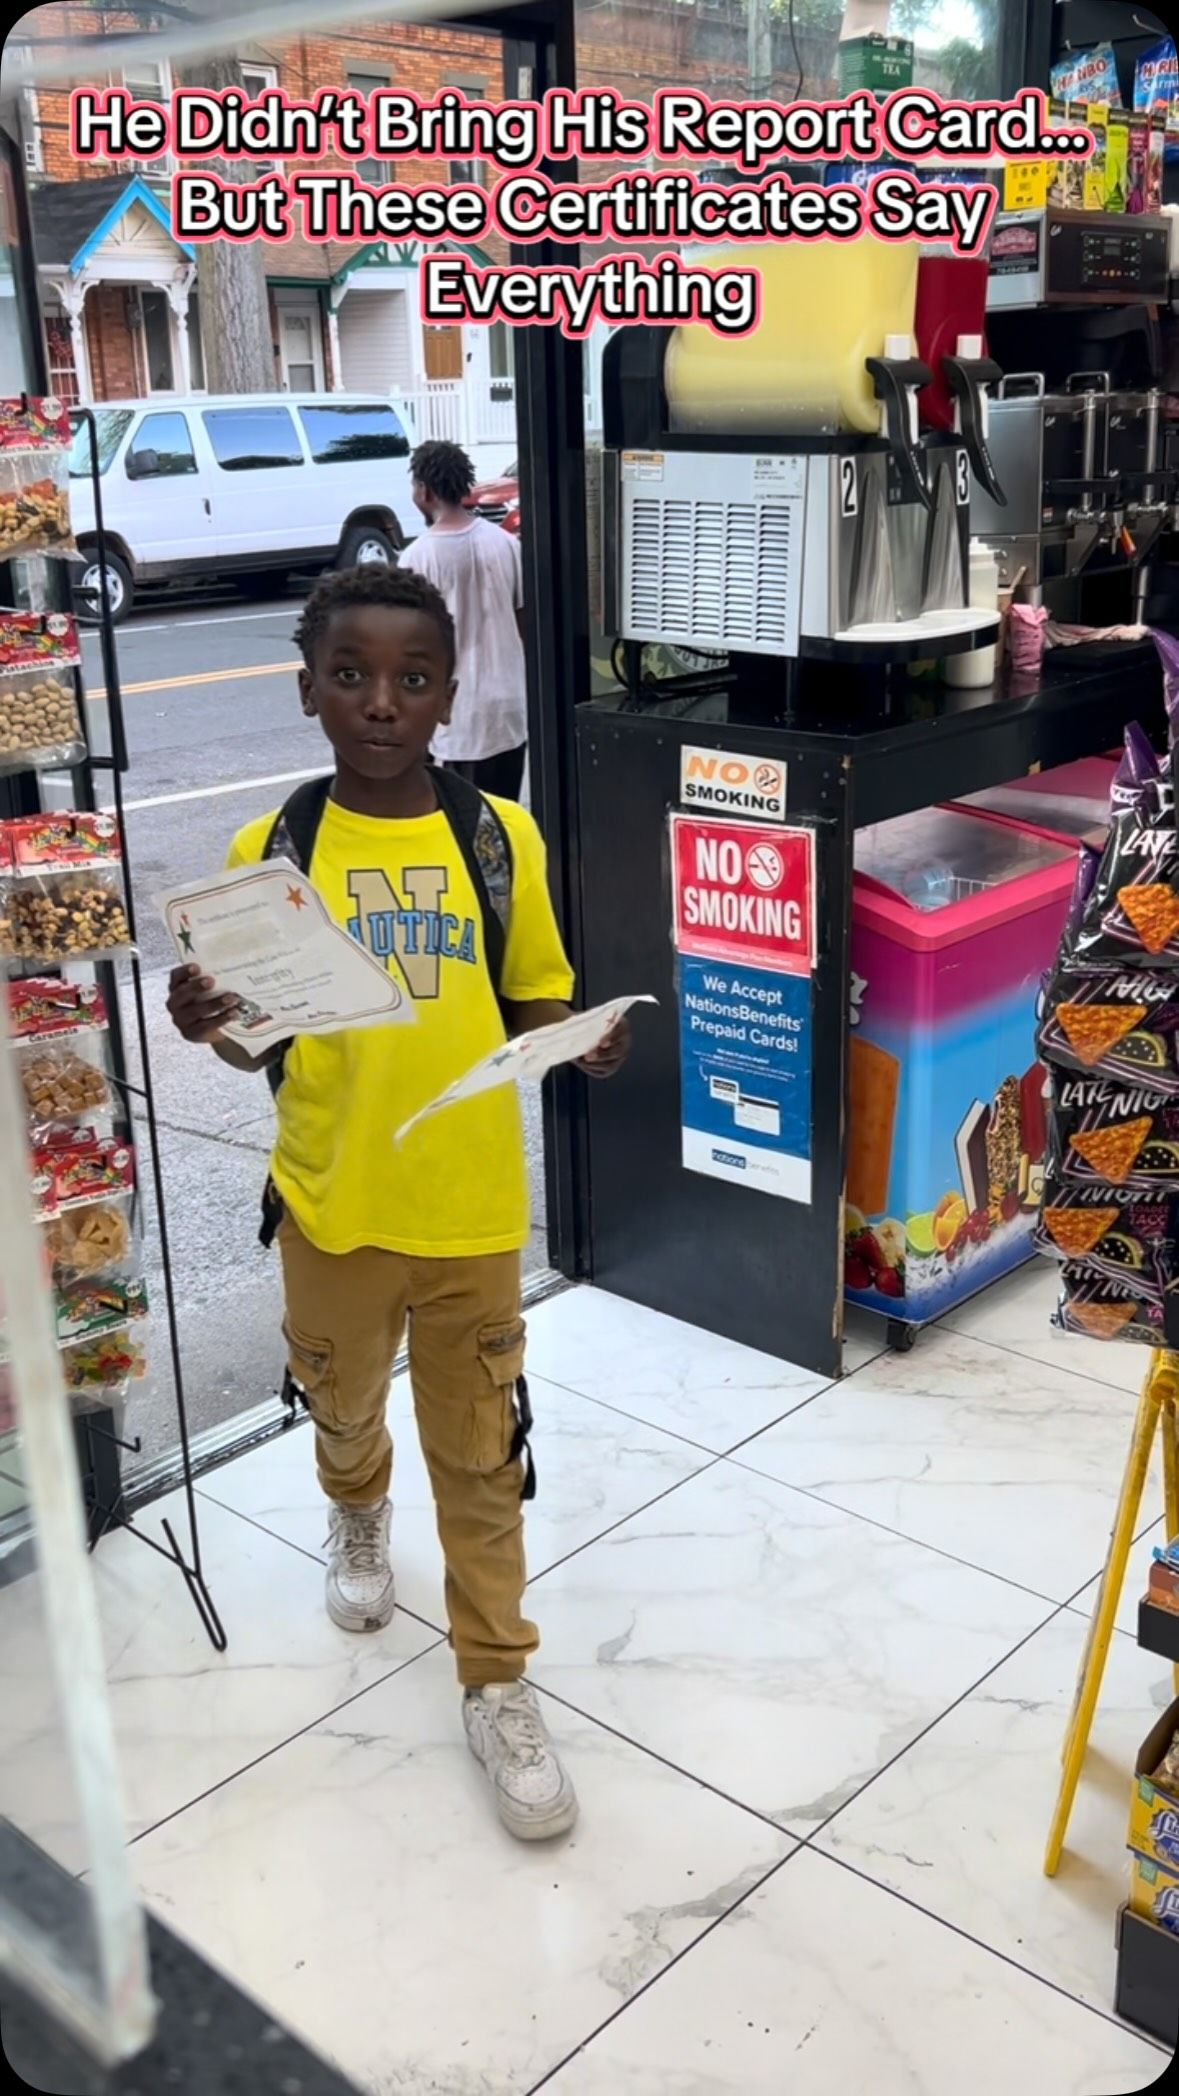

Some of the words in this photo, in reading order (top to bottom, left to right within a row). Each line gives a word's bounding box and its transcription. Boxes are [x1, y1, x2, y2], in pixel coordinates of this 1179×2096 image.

[882, 63, 901, 76] TEA
[842, 459, 856, 513] 2
[957, 452, 970, 502] 3
[687, 755, 750, 785] NO
[685, 783, 781, 813] SMOKING
[695, 837, 742, 885] NO
[684, 887, 802, 940] SMOKING
[703, 974, 728, 993] We
[730, 980, 783, 1006] Accept
[28, 1026, 79, 1043] Caramels
[690, 1015, 746, 1042] Prepaid
[749, 1028, 799, 1054] Cards!
[1060, 1080, 1113, 1107] LATE
